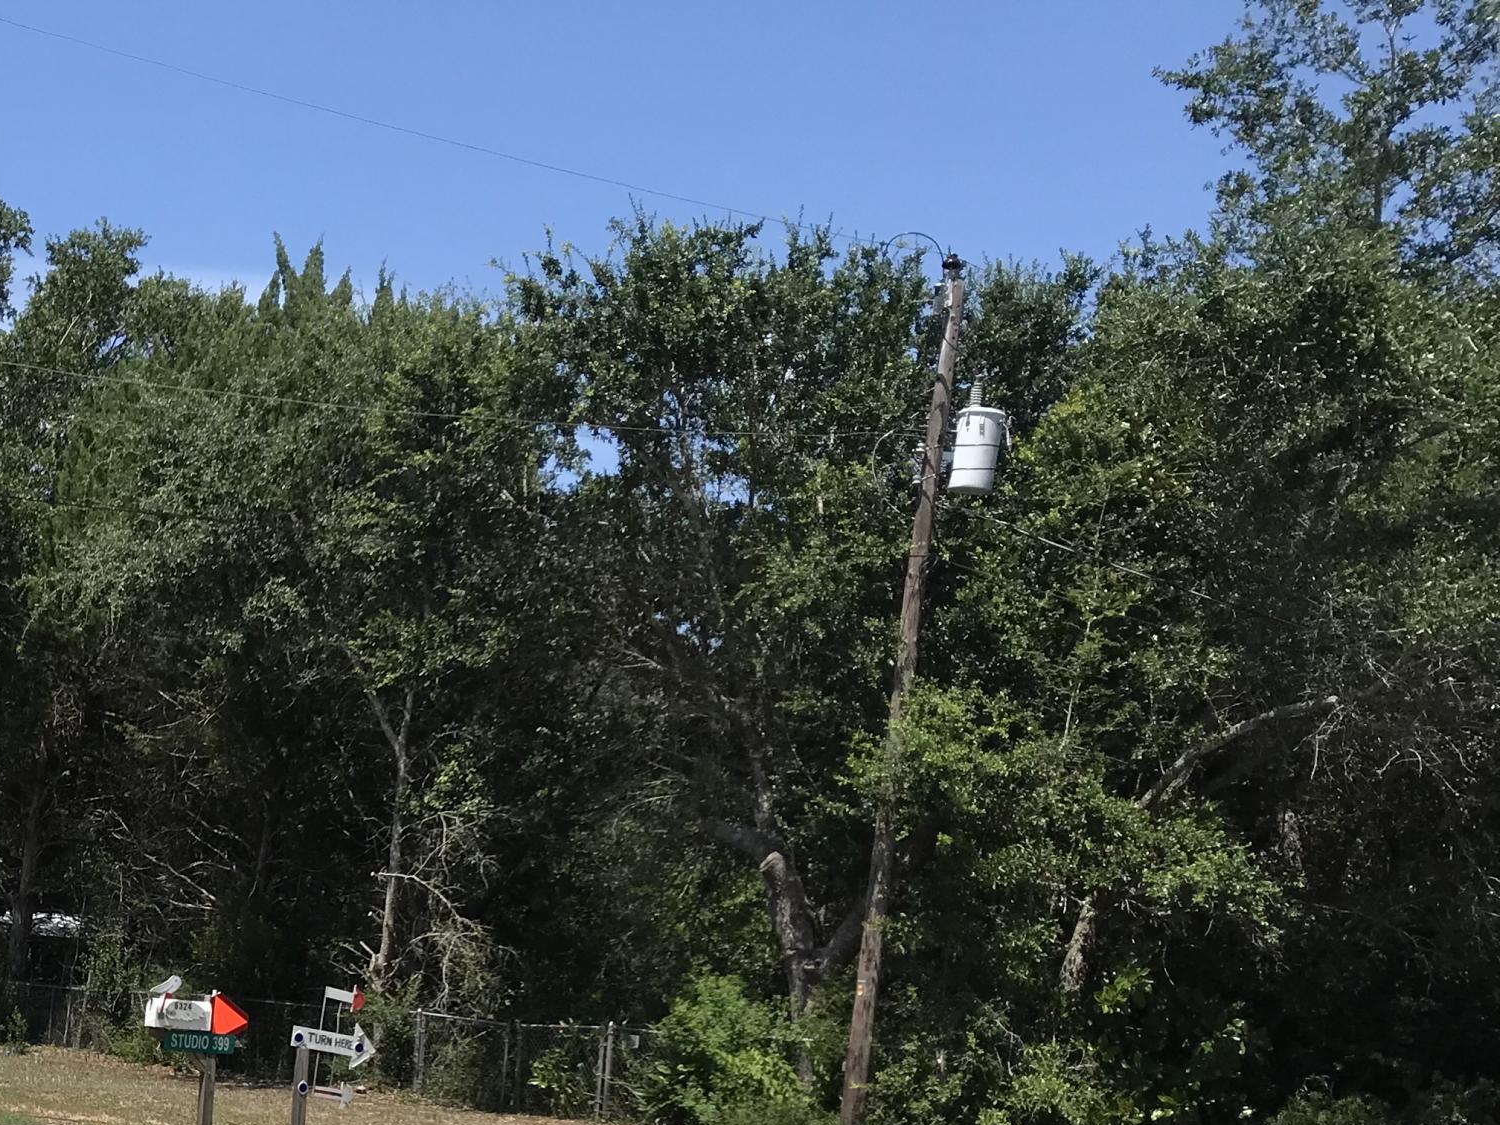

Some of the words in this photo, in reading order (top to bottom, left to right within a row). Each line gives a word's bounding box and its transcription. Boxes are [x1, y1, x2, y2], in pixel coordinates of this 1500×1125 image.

[170, 1033, 209, 1050] STUDIO
[212, 1036, 230, 1051] 399
[308, 1032, 332, 1046] TURN
[335, 1038, 354, 1051] HERE
